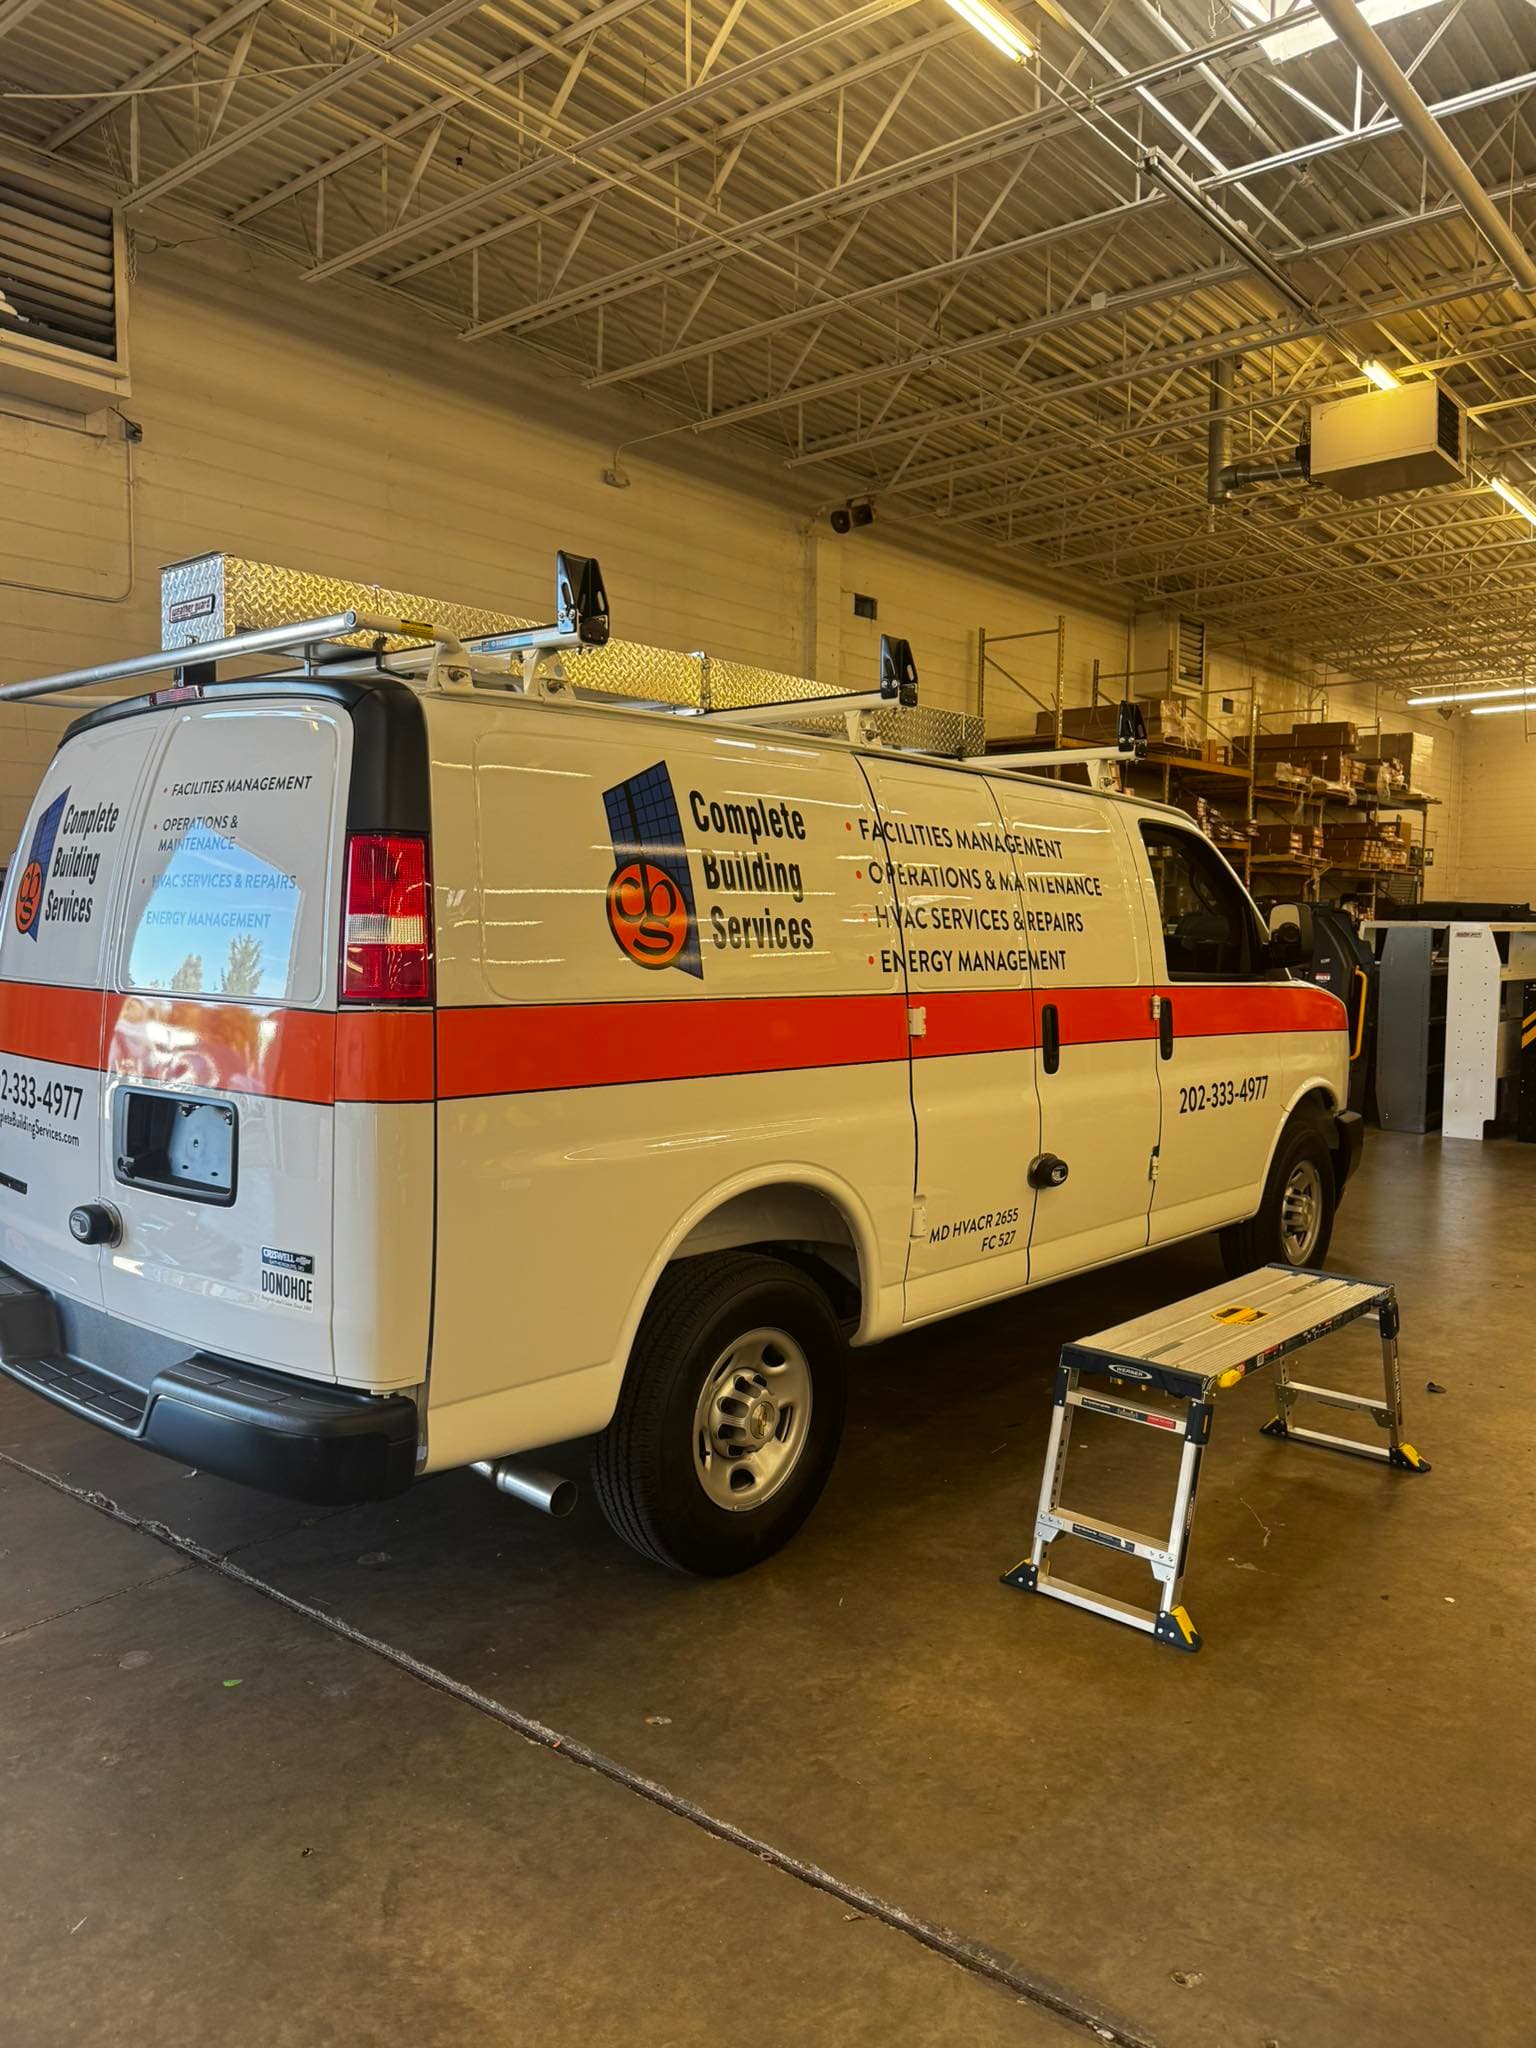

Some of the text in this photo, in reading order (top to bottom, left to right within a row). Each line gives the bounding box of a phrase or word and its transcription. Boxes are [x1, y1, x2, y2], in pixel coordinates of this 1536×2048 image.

[171, 775, 313, 796] FACILITIES MANAGEMENT
[62, 802, 119, 840] Complete
[163, 815, 238, 831] OPERATIONS &
[689, 790, 806, 844] Complete
[158, 837, 236, 852] MAINTENANCE
[858, 819, 1063, 859] FACILITIES MANAGEMENT
[52, 847, 100, 884] Building
[152, 875, 296, 889] HVAC SERVICES & REPAIRS
[702, 848, 804, 903] Building
[868, 861, 1102, 896] OPERATIONS & MANTENANCE
[45, 889, 93, 923] Services
[146, 911, 271, 928] ENERGY MANAGEMENT
[876, 905, 1083, 933] HVAC SERVICES & REPAIRS
[711, 905, 813, 949] Services
[881, 950, 1066, 973] ENERGY MANAGEMENT
[1179, 1075, 1269, 1114] 202-333-4977
[929, 1207, 1019, 1244] MD HVACR 2655
[981, 1230, 1016, 1252] FC 527
[262, 1269, 312, 1303] DONOHOE
